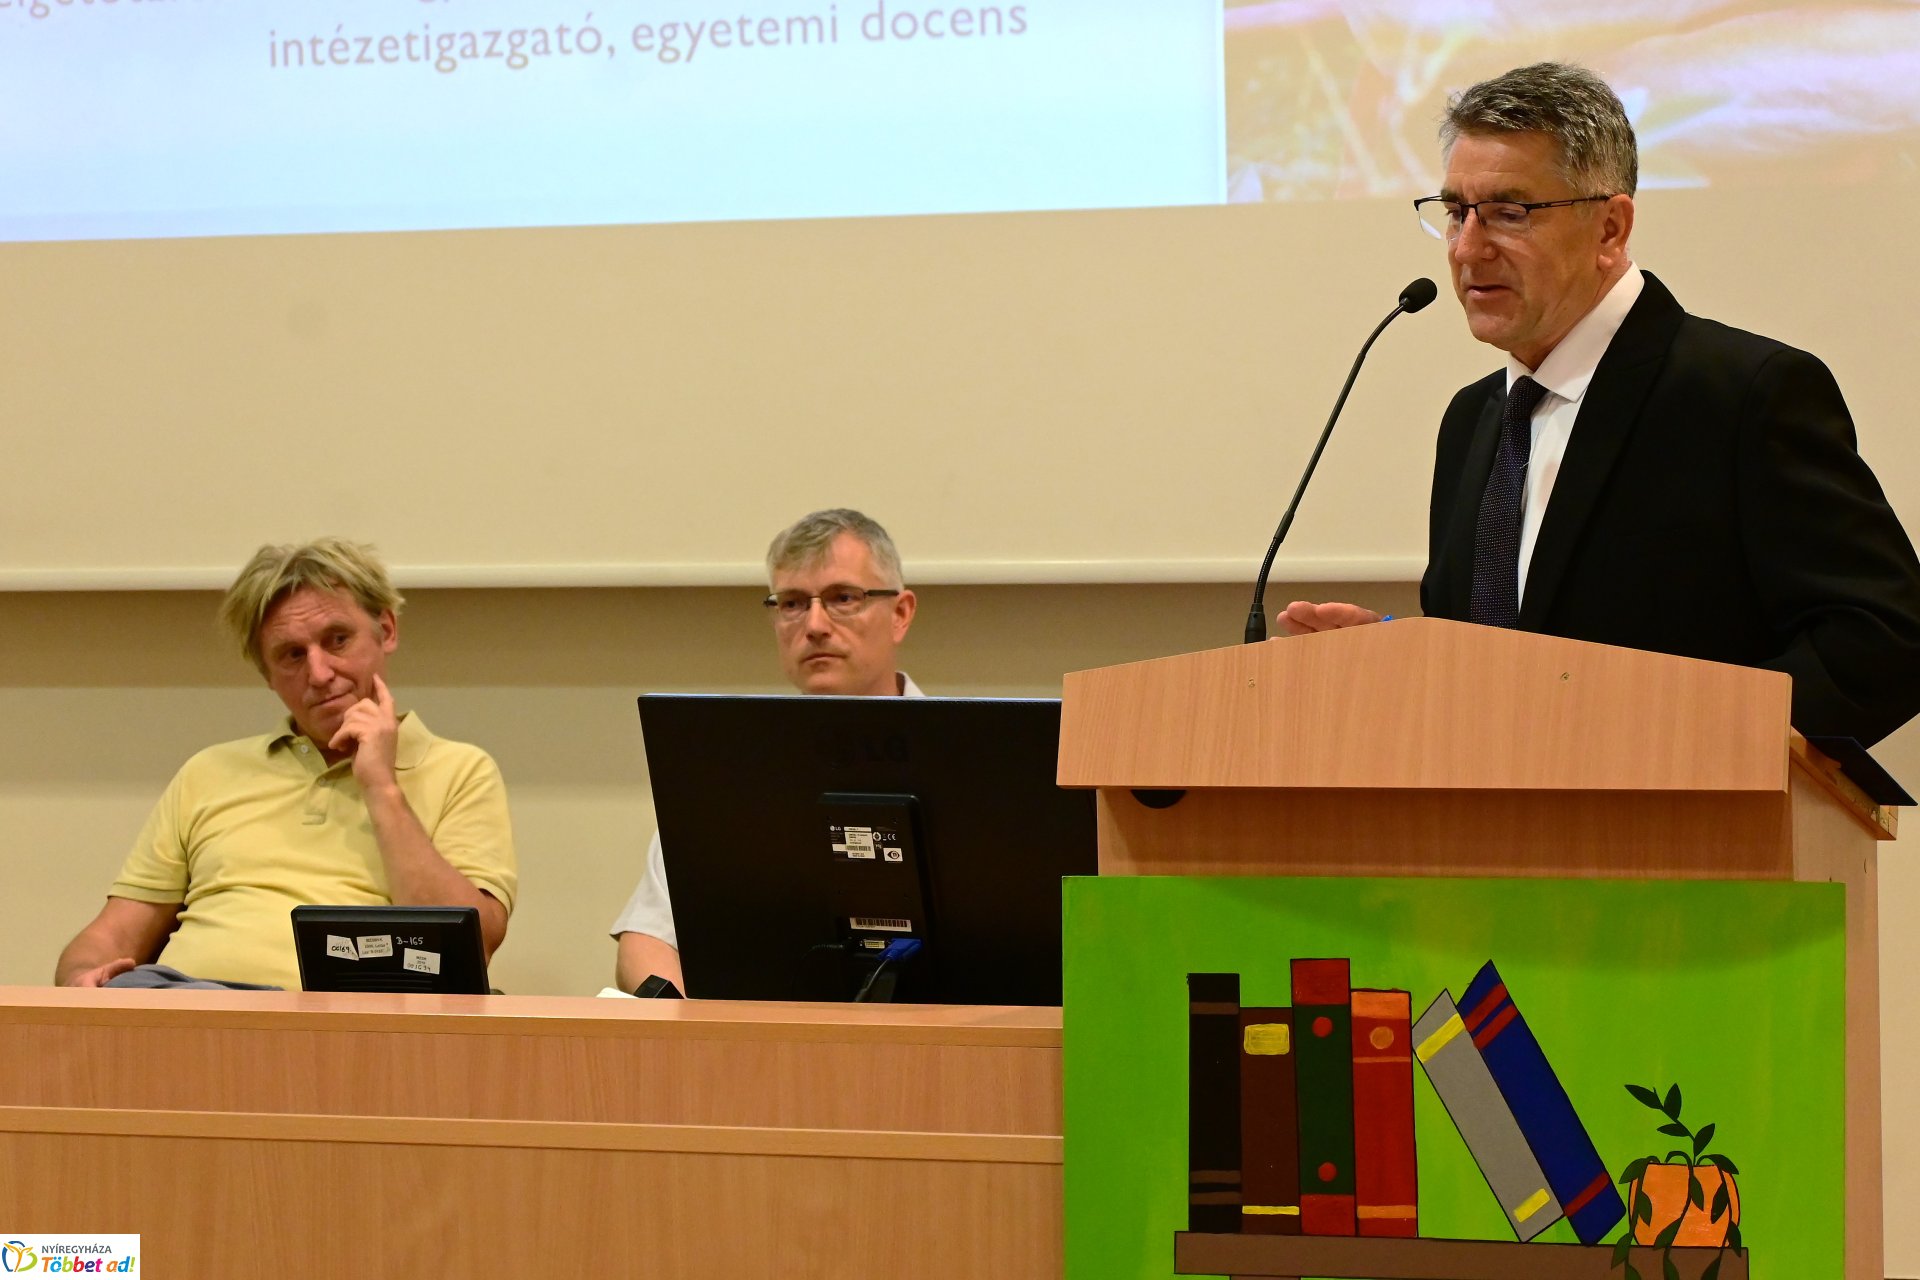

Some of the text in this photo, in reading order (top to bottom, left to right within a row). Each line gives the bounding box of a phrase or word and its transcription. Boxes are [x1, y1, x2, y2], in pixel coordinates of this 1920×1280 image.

[269, 0, 1028, 73] intézetigazgató, egyetemi docens
